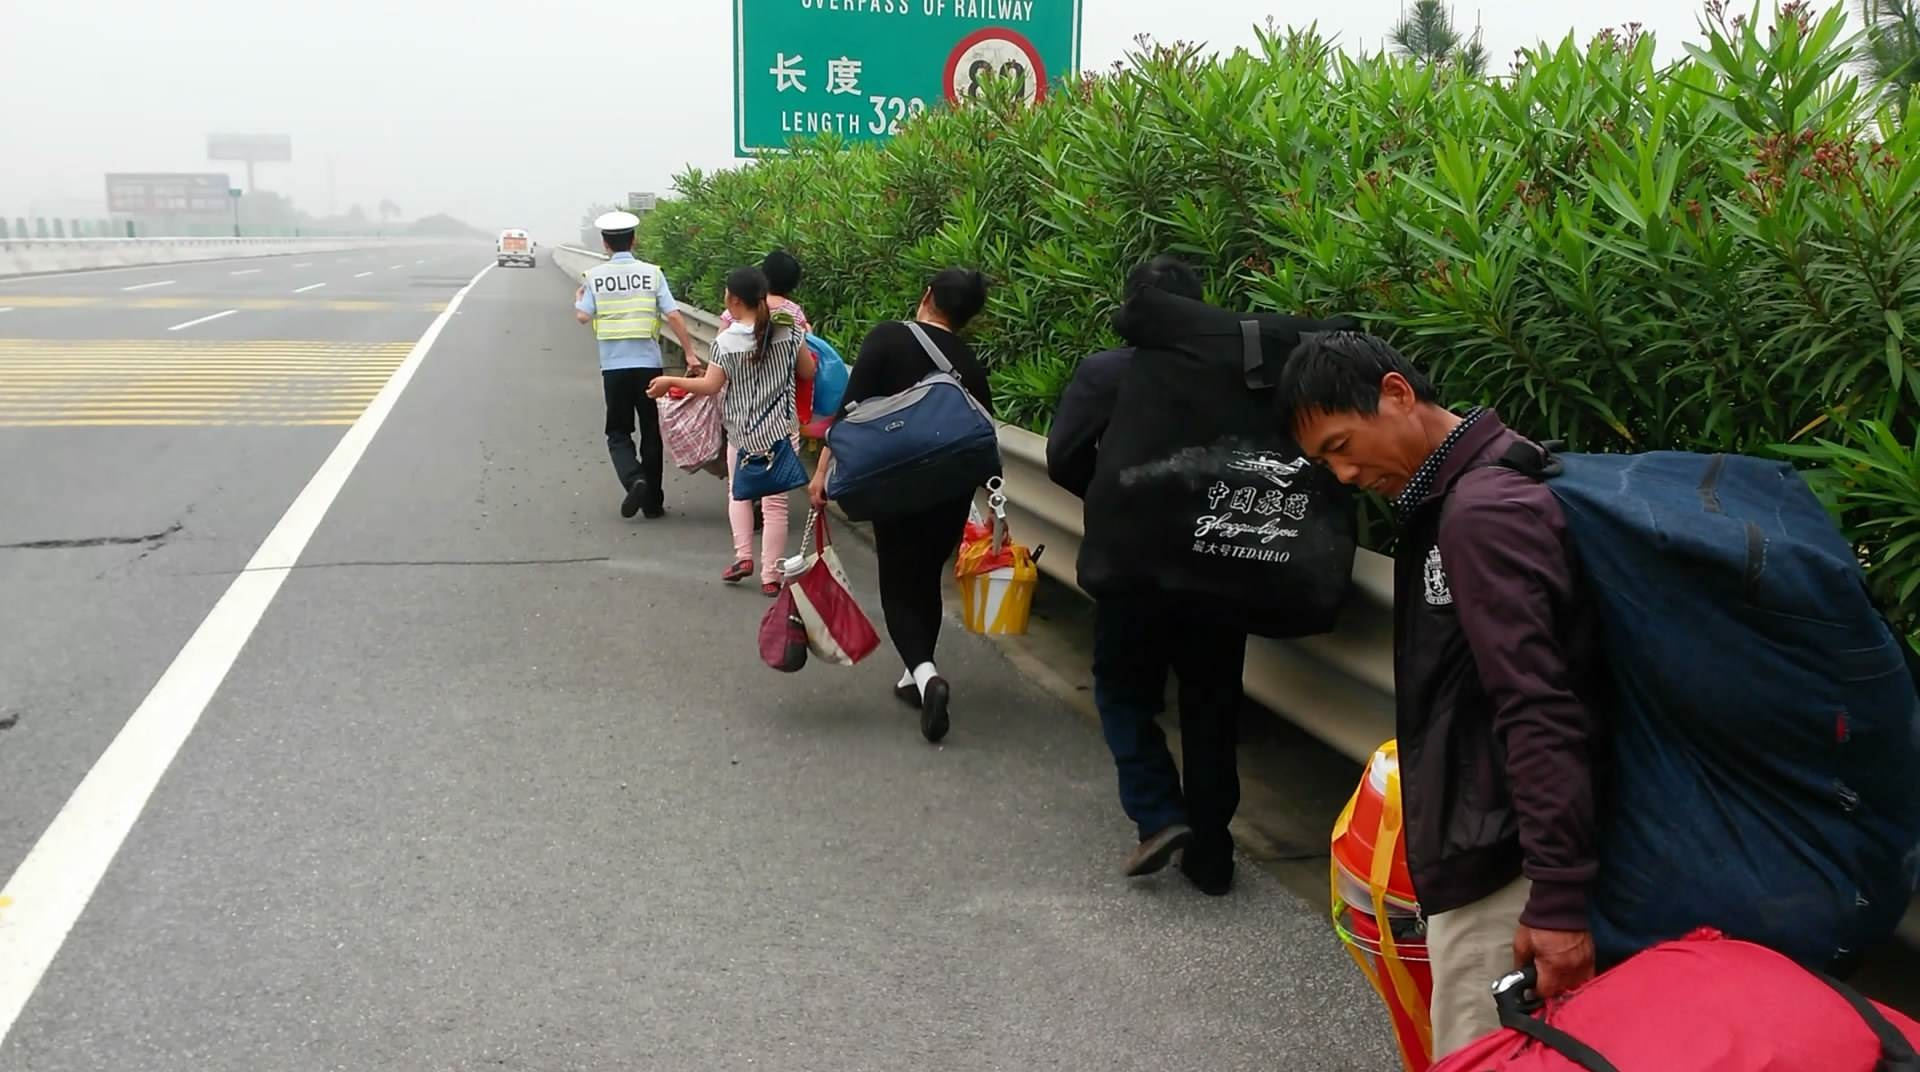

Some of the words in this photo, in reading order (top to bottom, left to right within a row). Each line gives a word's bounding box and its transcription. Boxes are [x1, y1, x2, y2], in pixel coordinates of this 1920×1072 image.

[923, 0, 945, 16] OF
[954, 0, 1033, 21] RAILWAY
[769, 53, 863, 96] 长度
[782, 111, 859, 134] LENGTH
[594, 274, 652, 292] POLICE
